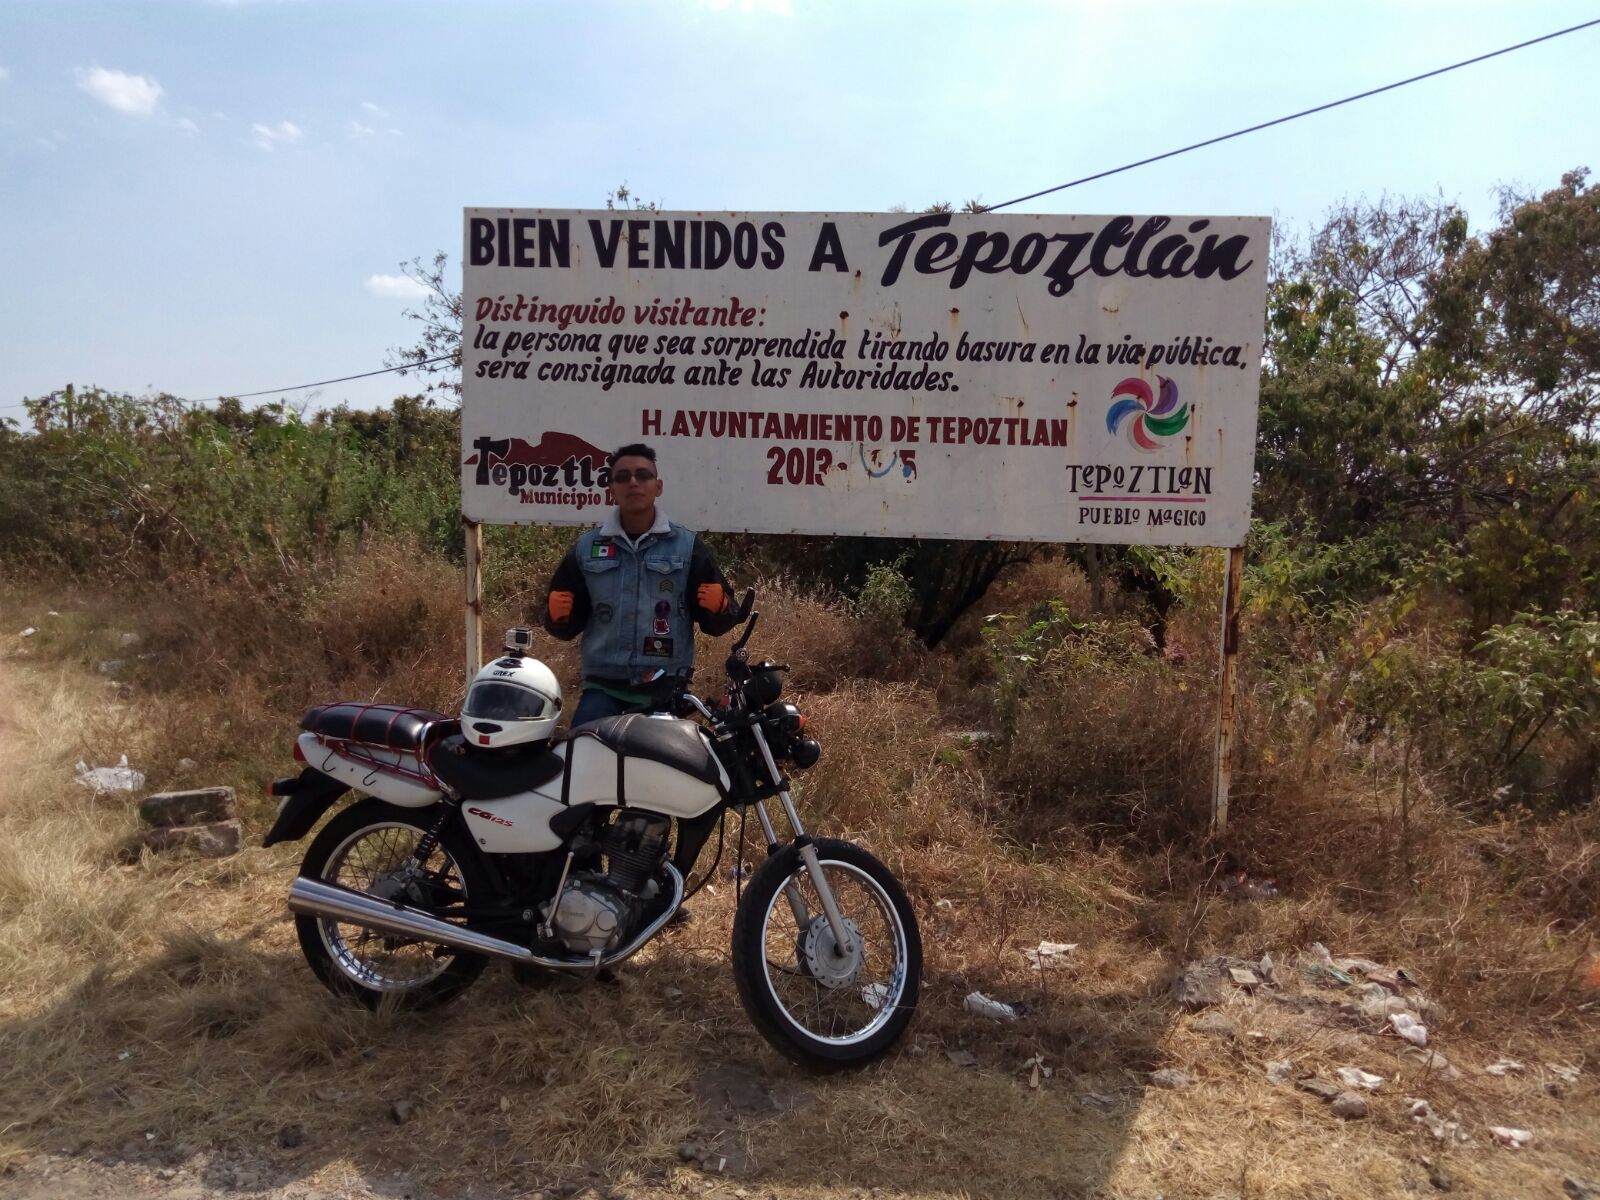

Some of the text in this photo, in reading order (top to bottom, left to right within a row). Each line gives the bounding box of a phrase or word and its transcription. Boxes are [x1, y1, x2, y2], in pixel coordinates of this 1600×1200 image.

[470, 213, 1254, 298] BIEN VENIDOS A Tepoztlán
[475, 294, 766, 331] Distinguido visitante:
[473, 324, 500, 350] la
[501, 330, 602, 359] persona
[608, 334, 649, 361] que
[653, 335, 694, 356] sea
[701, 329, 846, 361] sorprendida
[858, 329, 949, 362] tirando
[955, 331, 1035, 363] basura
[1040, 343, 1070, 365] en
[1074, 334, 1101, 365] la
[1144, 336, 1246, 371] pública,
[475, 351, 960, 392] será consignada ante las Autoridades.
[890, 415, 920, 443] DE
[926, 416, 1068, 447] TEPOZTLAN
[520, 487, 601, 511] Municipio
